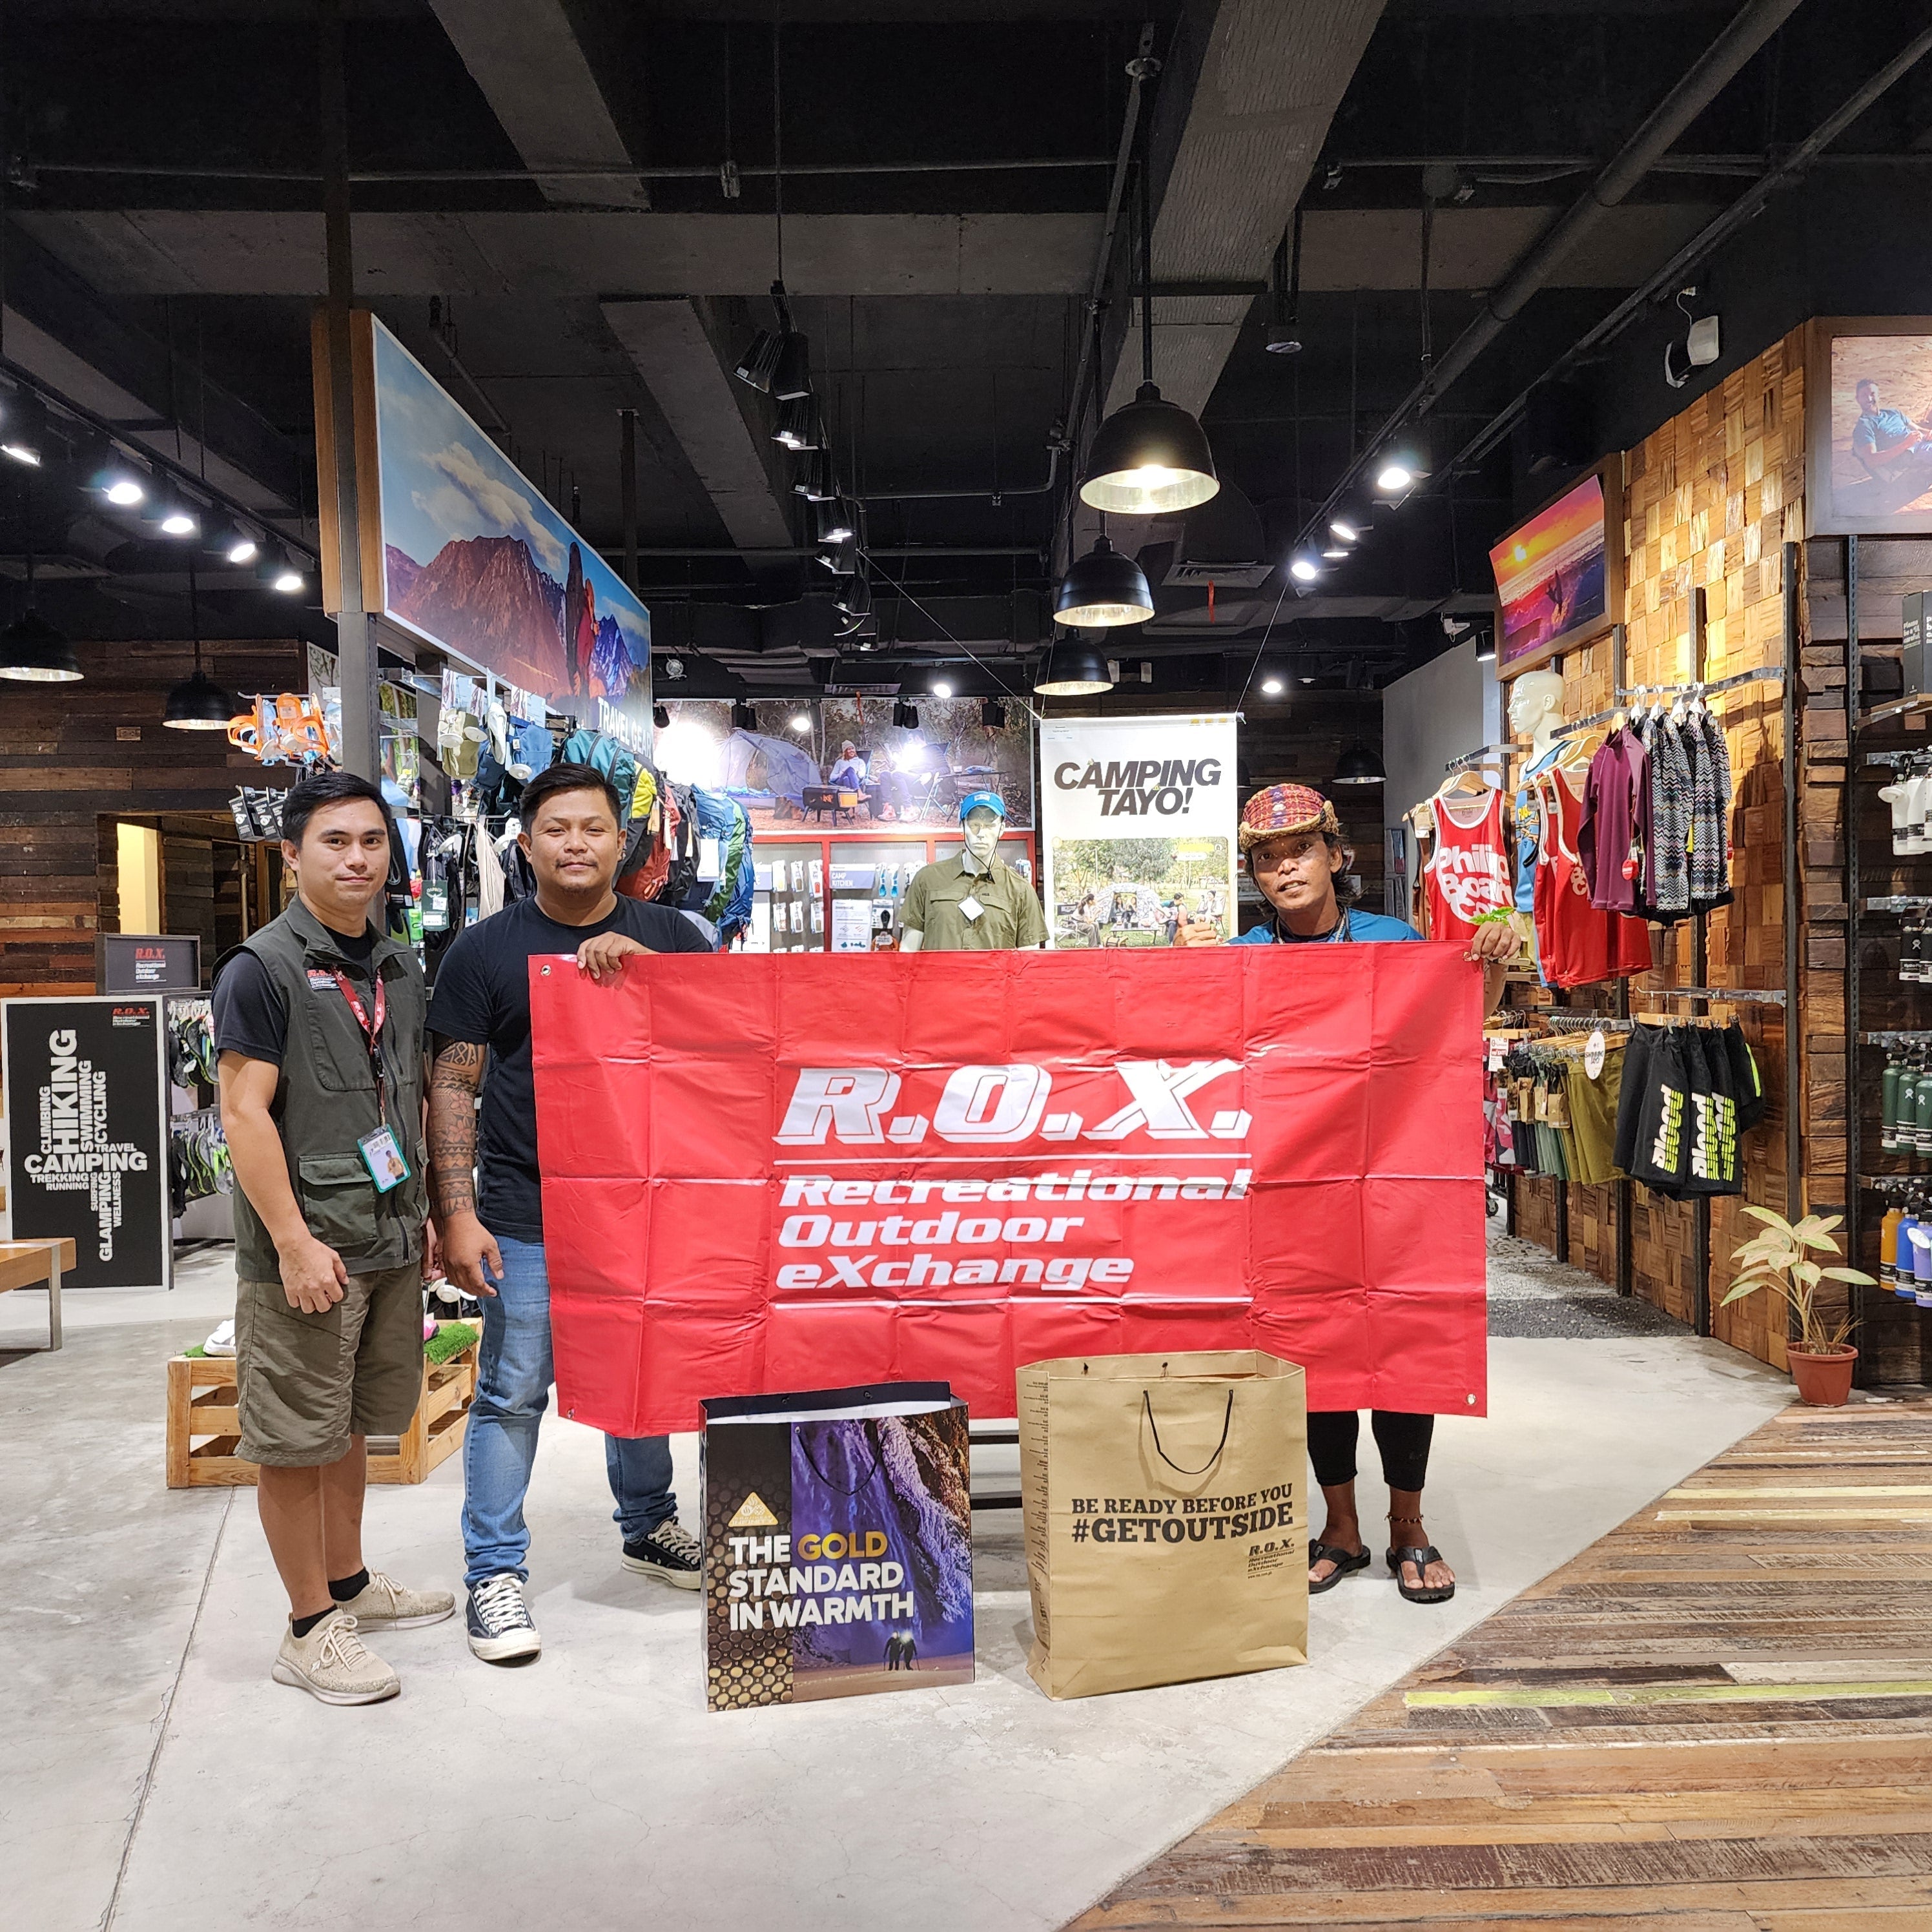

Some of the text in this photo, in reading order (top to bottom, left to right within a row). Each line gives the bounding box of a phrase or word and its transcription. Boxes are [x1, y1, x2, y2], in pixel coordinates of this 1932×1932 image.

[598, 696, 652, 761] TRAVEL GEAR
[1054, 758, 1222, 790] CAMPING
[1098, 786, 1194, 816] TAYO!
[136, 948, 165, 960] R.O.X.
[49, 1029, 79, 1154] HIKING
[78, 1060, 94, 1153] SWIMMING
[92, 1071, 108, 1144] CYCLING
[772, 1058, 1253, 1146] R.O.X.
[39, 1085, 52, 1154] CLIMBING
[24, 1151, 148, 1174] CAMPING
[95, 1142, 137, 1153] TRAVEL
[30, 1172, 89, 1183] TREKKING
[46, 1182, 89, 1191] RUNNING
[90, 1172, 98, 1211] SURFING
[779, 1169, 1253, 1206] Recreational
[98, 1171, 113, 1262] GLAMPING
[112, 1171, 122, 1228] WELLNESS
[779, 1211, 1085, 1248] Outdoor
[776, 1253, 1135, 1290] eXchange
[1071, 1483, 1293, 1514] BE READY BEFORE YOU
[1071, 1501, 1293, 1543] #GETOUTSIDE
[729, 1531, 888, 1565] THE GOLD
[1249, 1537, 1295, 1557] R.O.X.
[729, 1561, 904, 1598] STANDARD
[730, 1591, 914, 1631] IN WARMTH
